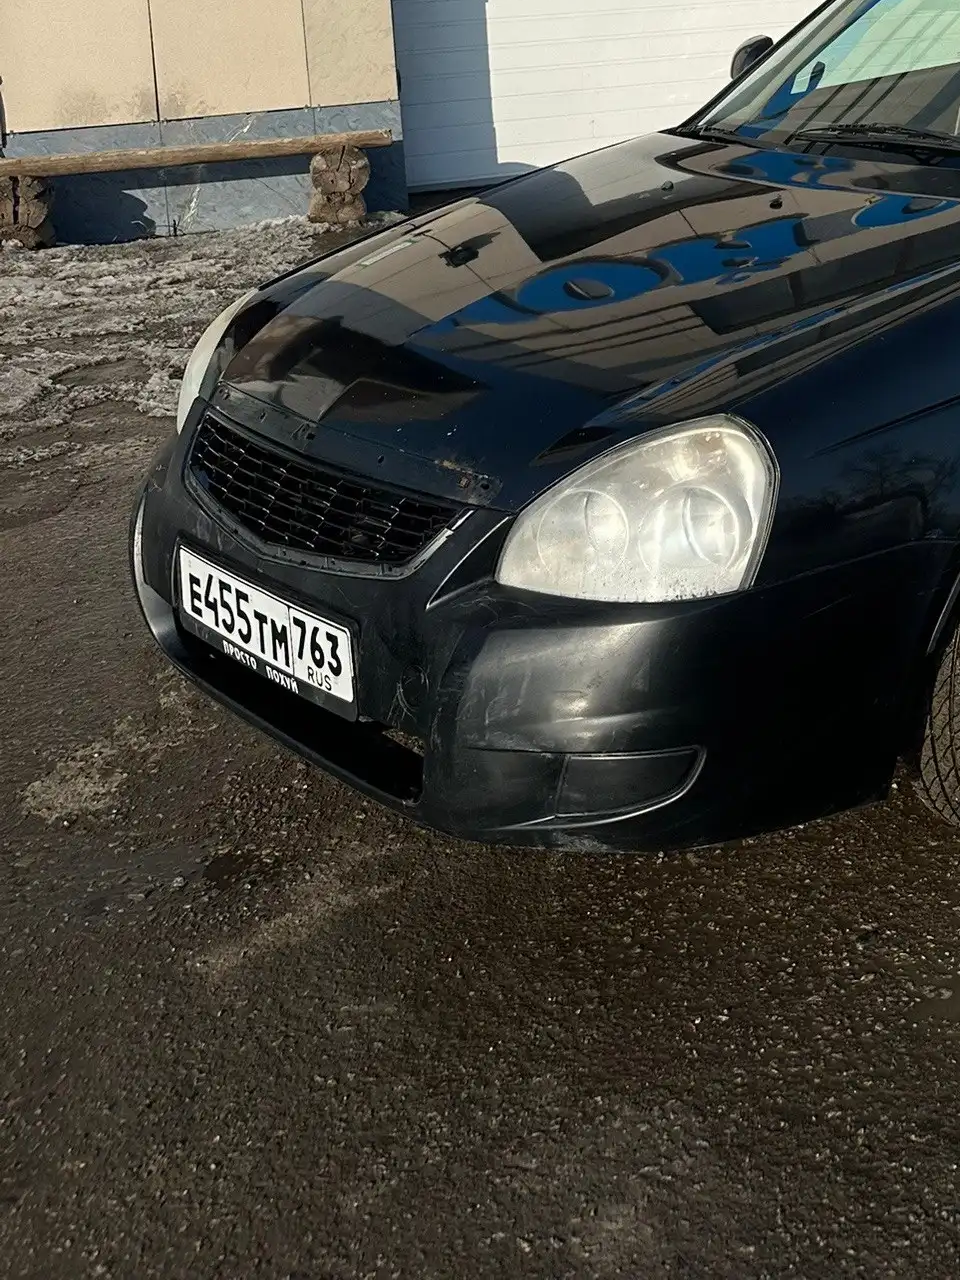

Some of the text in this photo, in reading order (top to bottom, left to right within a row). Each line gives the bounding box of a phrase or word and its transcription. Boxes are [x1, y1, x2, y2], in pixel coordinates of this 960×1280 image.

[222, 639, 298, 694] ПРОСТО ПОХУЙ
[293, 616, 342, 677] 763
[307, 665, 332, 692] RUS
